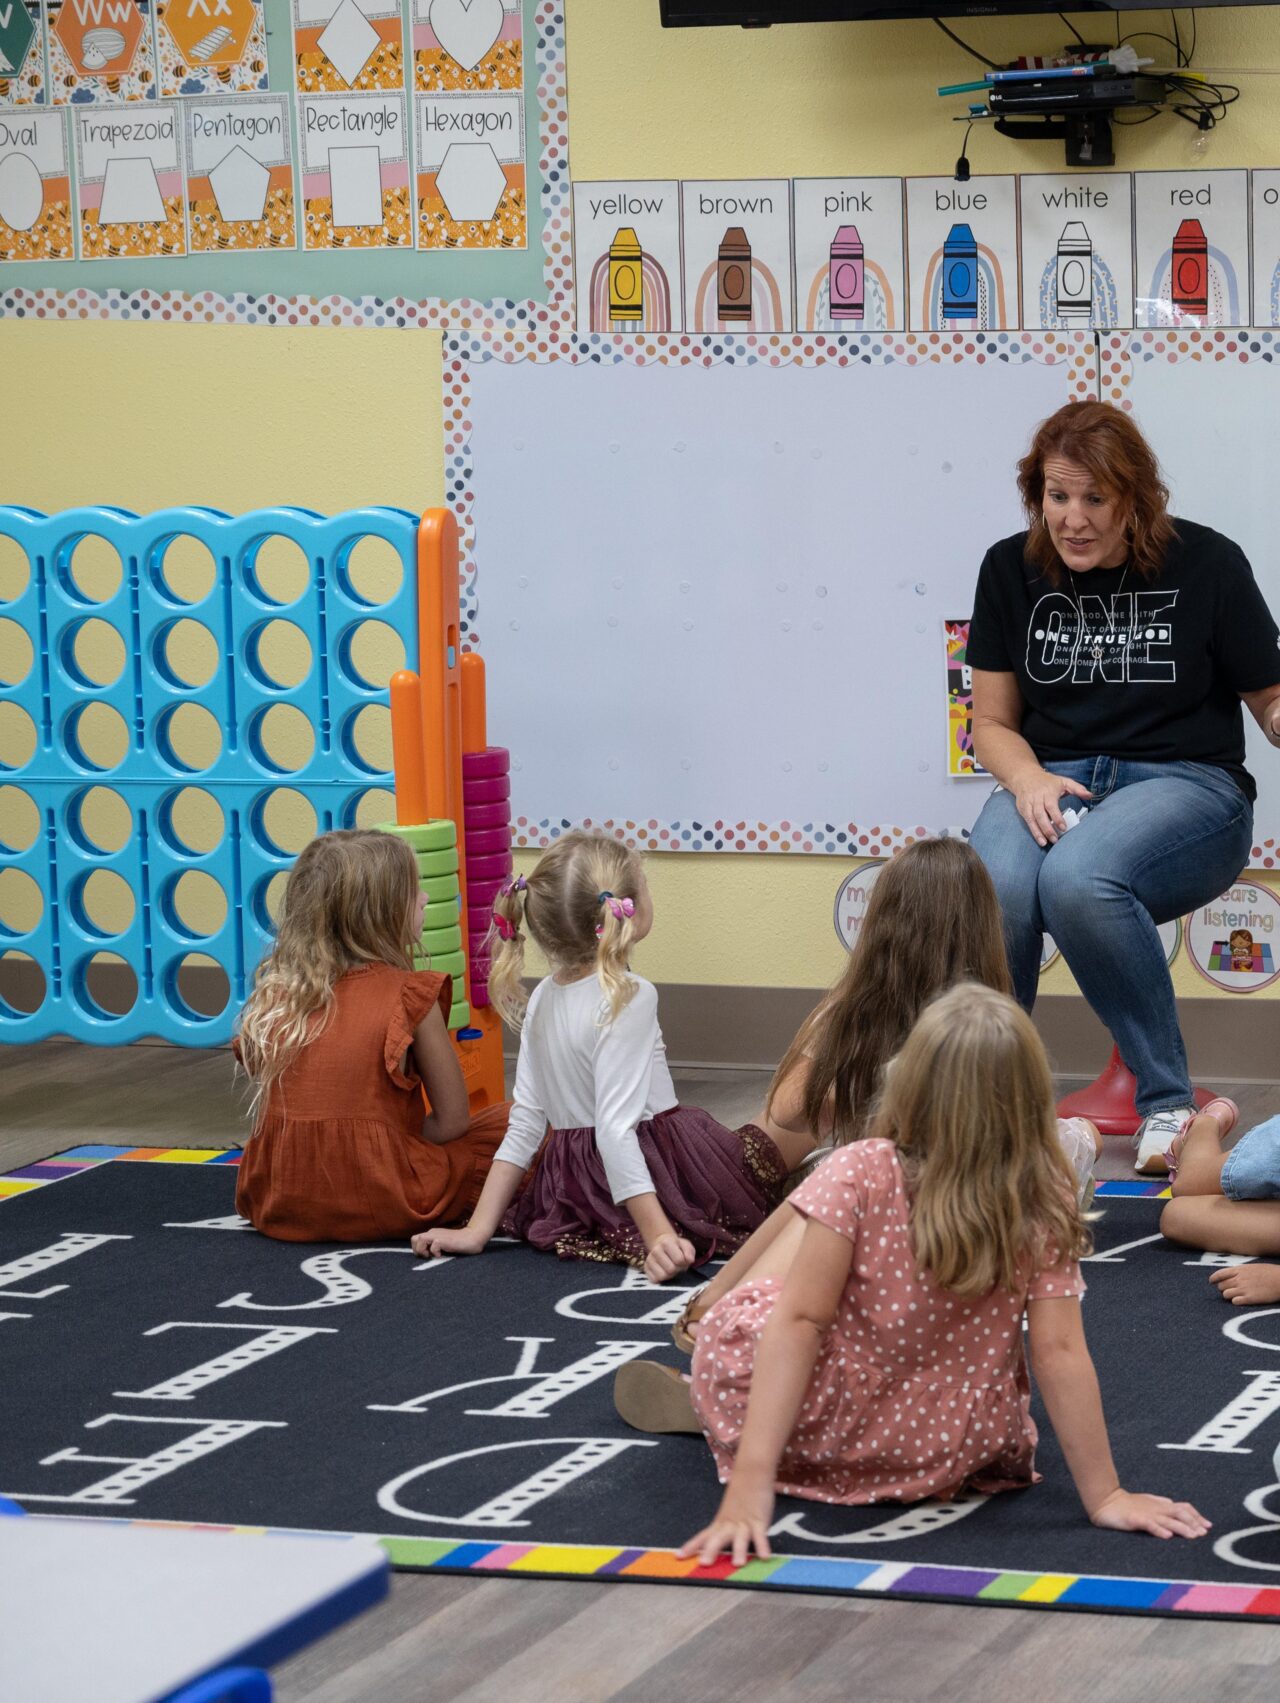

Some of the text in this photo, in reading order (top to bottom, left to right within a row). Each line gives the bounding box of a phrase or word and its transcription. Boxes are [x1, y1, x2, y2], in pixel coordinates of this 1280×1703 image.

[80, 115, 174, 149] Trapezoid
[193, 112, 282, 142] Pentagon
[306, 105, 398, 137] Rectangle
[425, 106, 513, 137] Hexagon
[589, 193, 664, 220] yellow
[699, 193, 773, 215] brown
[824, 190, 873, 215] pink
[935, 189, 988, 212] blue
[1042, 186, 1109, 209] white
[1170, 182, 1212, 206] red
[1034, 629, 1070, 644] ONE
[1083, 633, 1127, 645] TRUE
[1077, 646, 1105, 654] SPAK
[1203, 908, 1274, 933] listening
[376, 1436, 660, 1528] D
